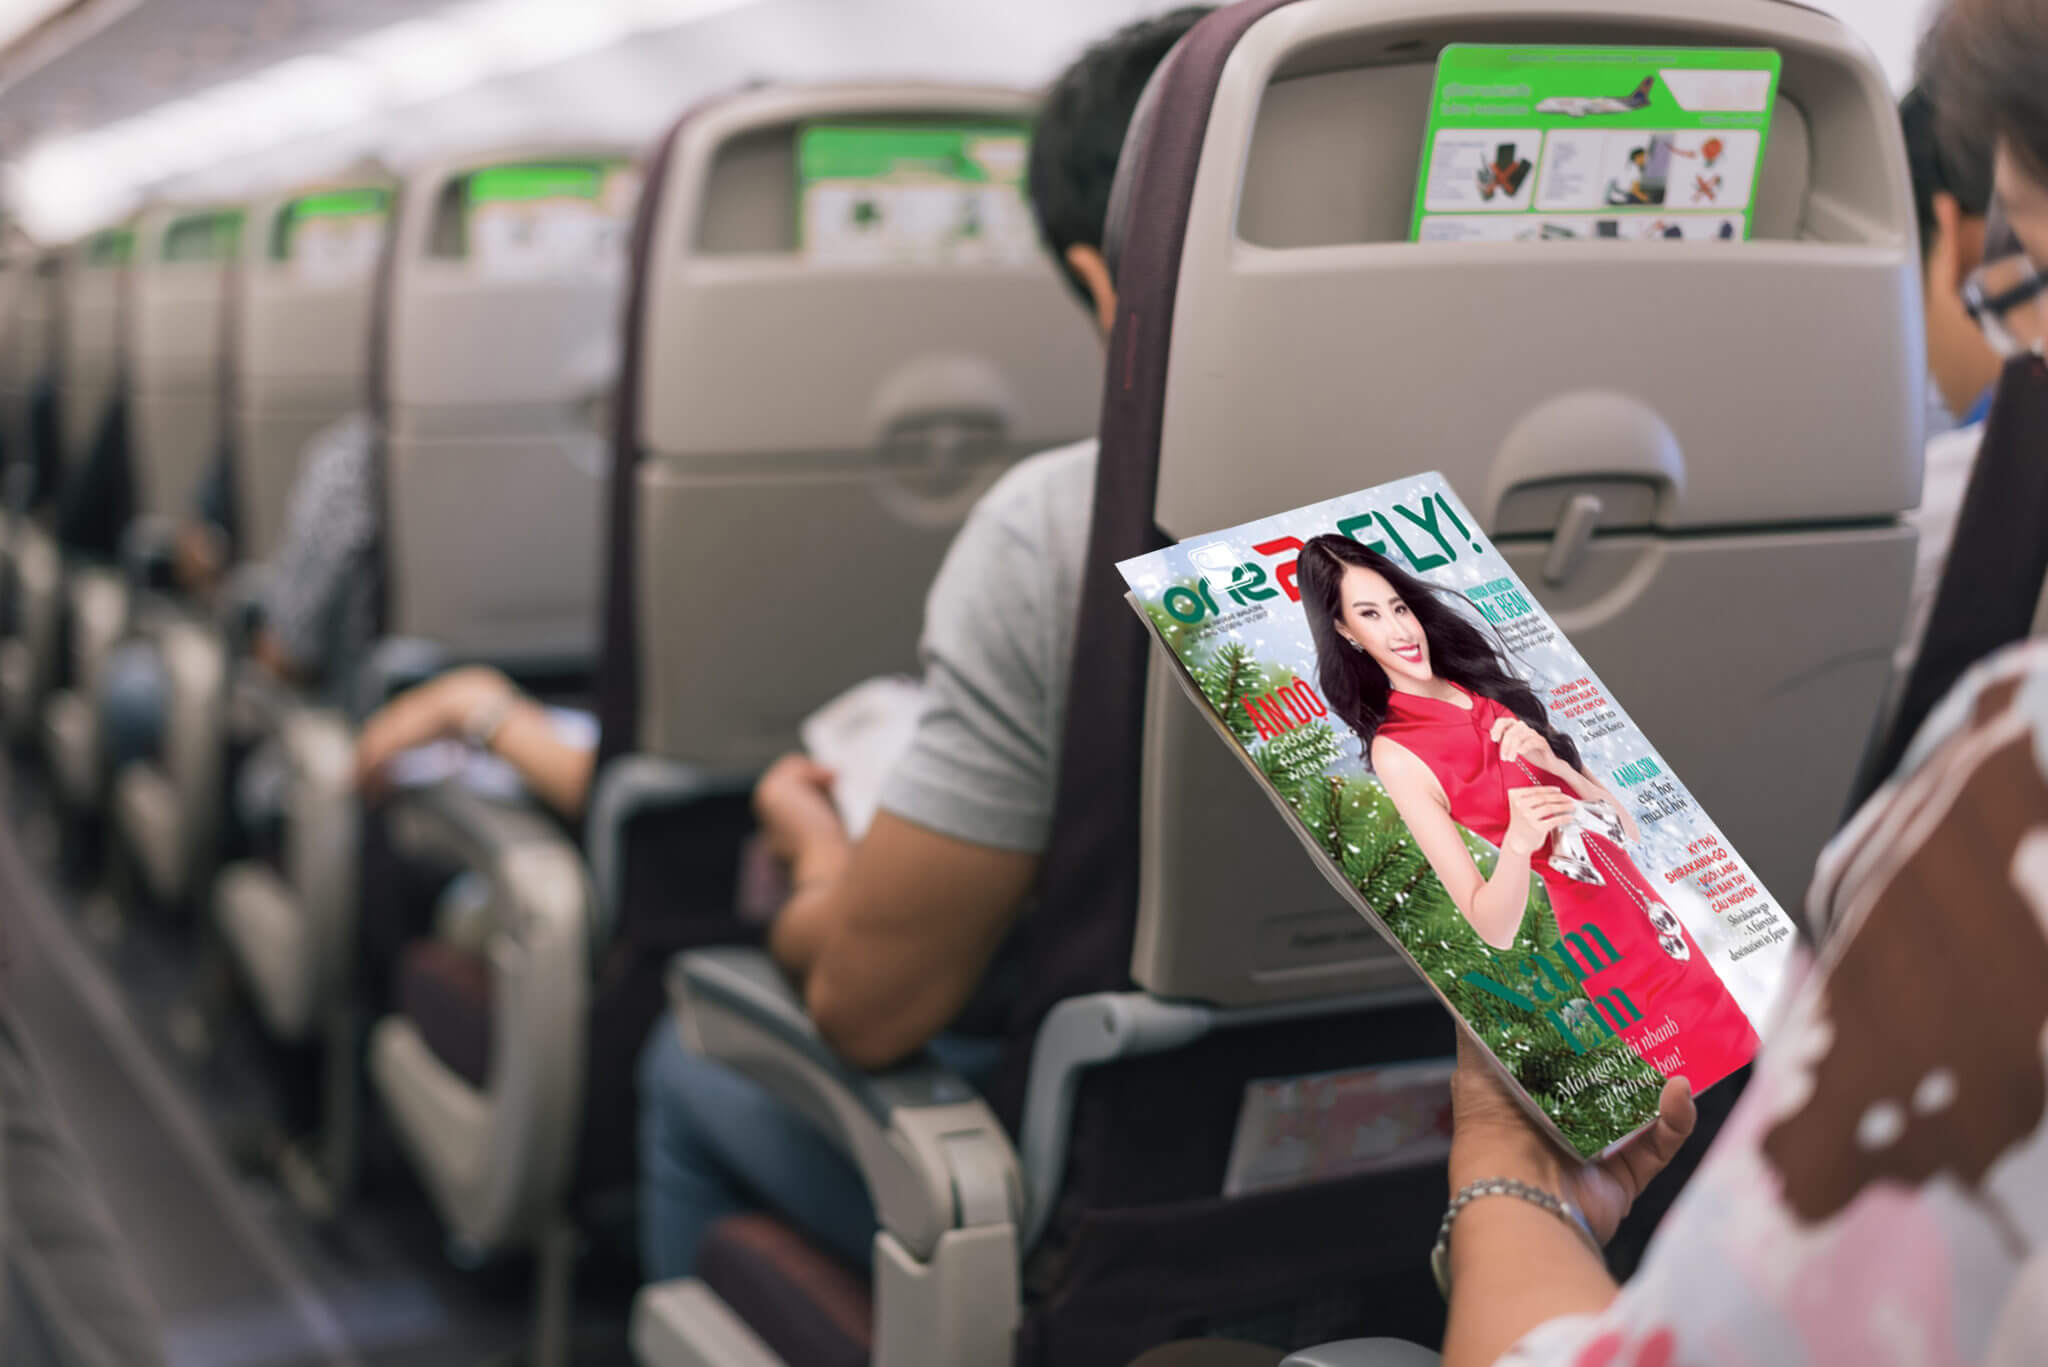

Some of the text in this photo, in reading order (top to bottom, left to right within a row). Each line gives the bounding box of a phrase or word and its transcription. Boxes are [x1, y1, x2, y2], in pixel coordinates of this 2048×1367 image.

[1494, 590, 1533, 619] BEAN
[1664, 847, 1728, 884] SHIRAKAWA-GO
[1462, 922, 1625, 1030] Nam
[1545, 986, 1645, 1057] Em
